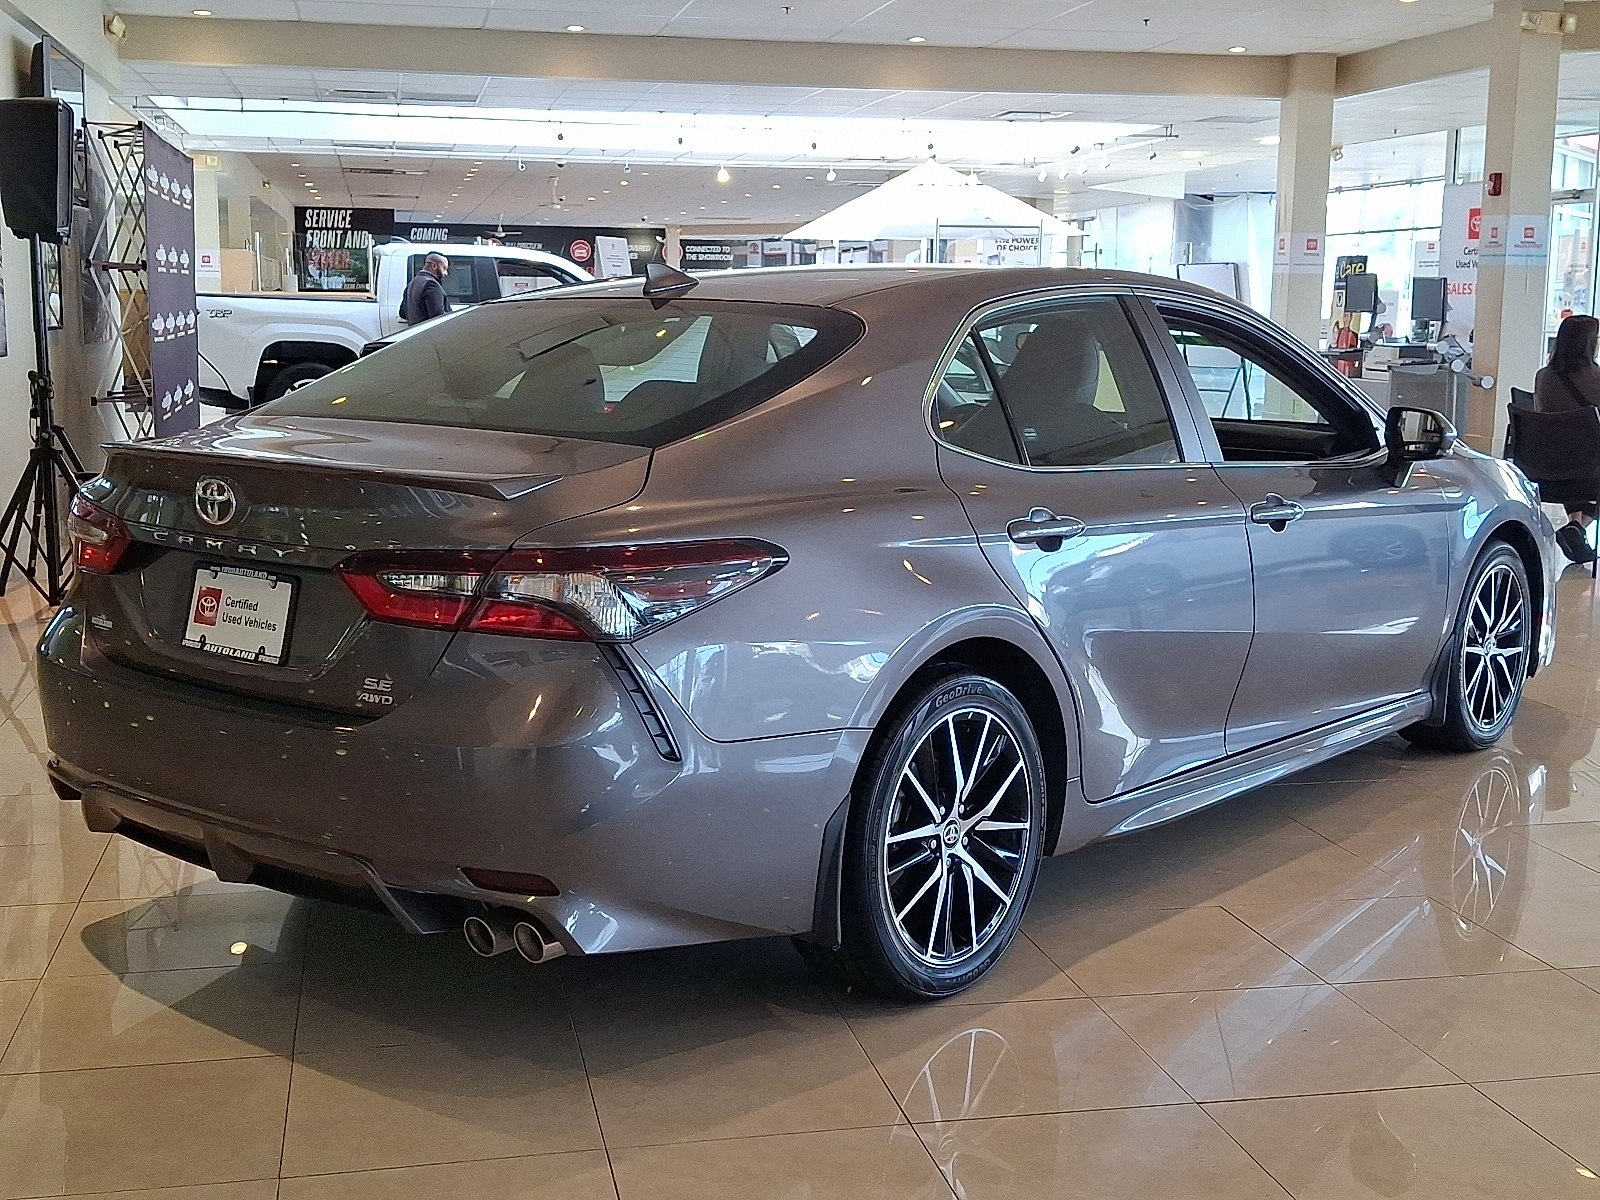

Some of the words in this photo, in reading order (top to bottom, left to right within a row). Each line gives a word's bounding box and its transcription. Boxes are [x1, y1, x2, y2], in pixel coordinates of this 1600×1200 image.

[305, 209, 353, 228] SERVICE
[305, 229, 345, 249] FRONT
[345, 231, 370, 250] AND
[410, 227, 448, 241] COMING
[628, 244, 651, 252] OVERED
[685, 245, 722, 253] CONNECTED
[1455, 260, 1471, 269] Used
[1446, 283, 1473, 295] SALES
[153, 531, 294, 557] CAMRY
[225, 596, 259, 612] Certified
[222, 612, 242, 626] Used
[243, 616, 278, 632] Vehicles
[203, 643, 256, 661] AUTOLAND
[362, 677, 394, 692] SE
[357, 692, 394, 705] AWD
[935, 683, 984, 708] GeoDrive
